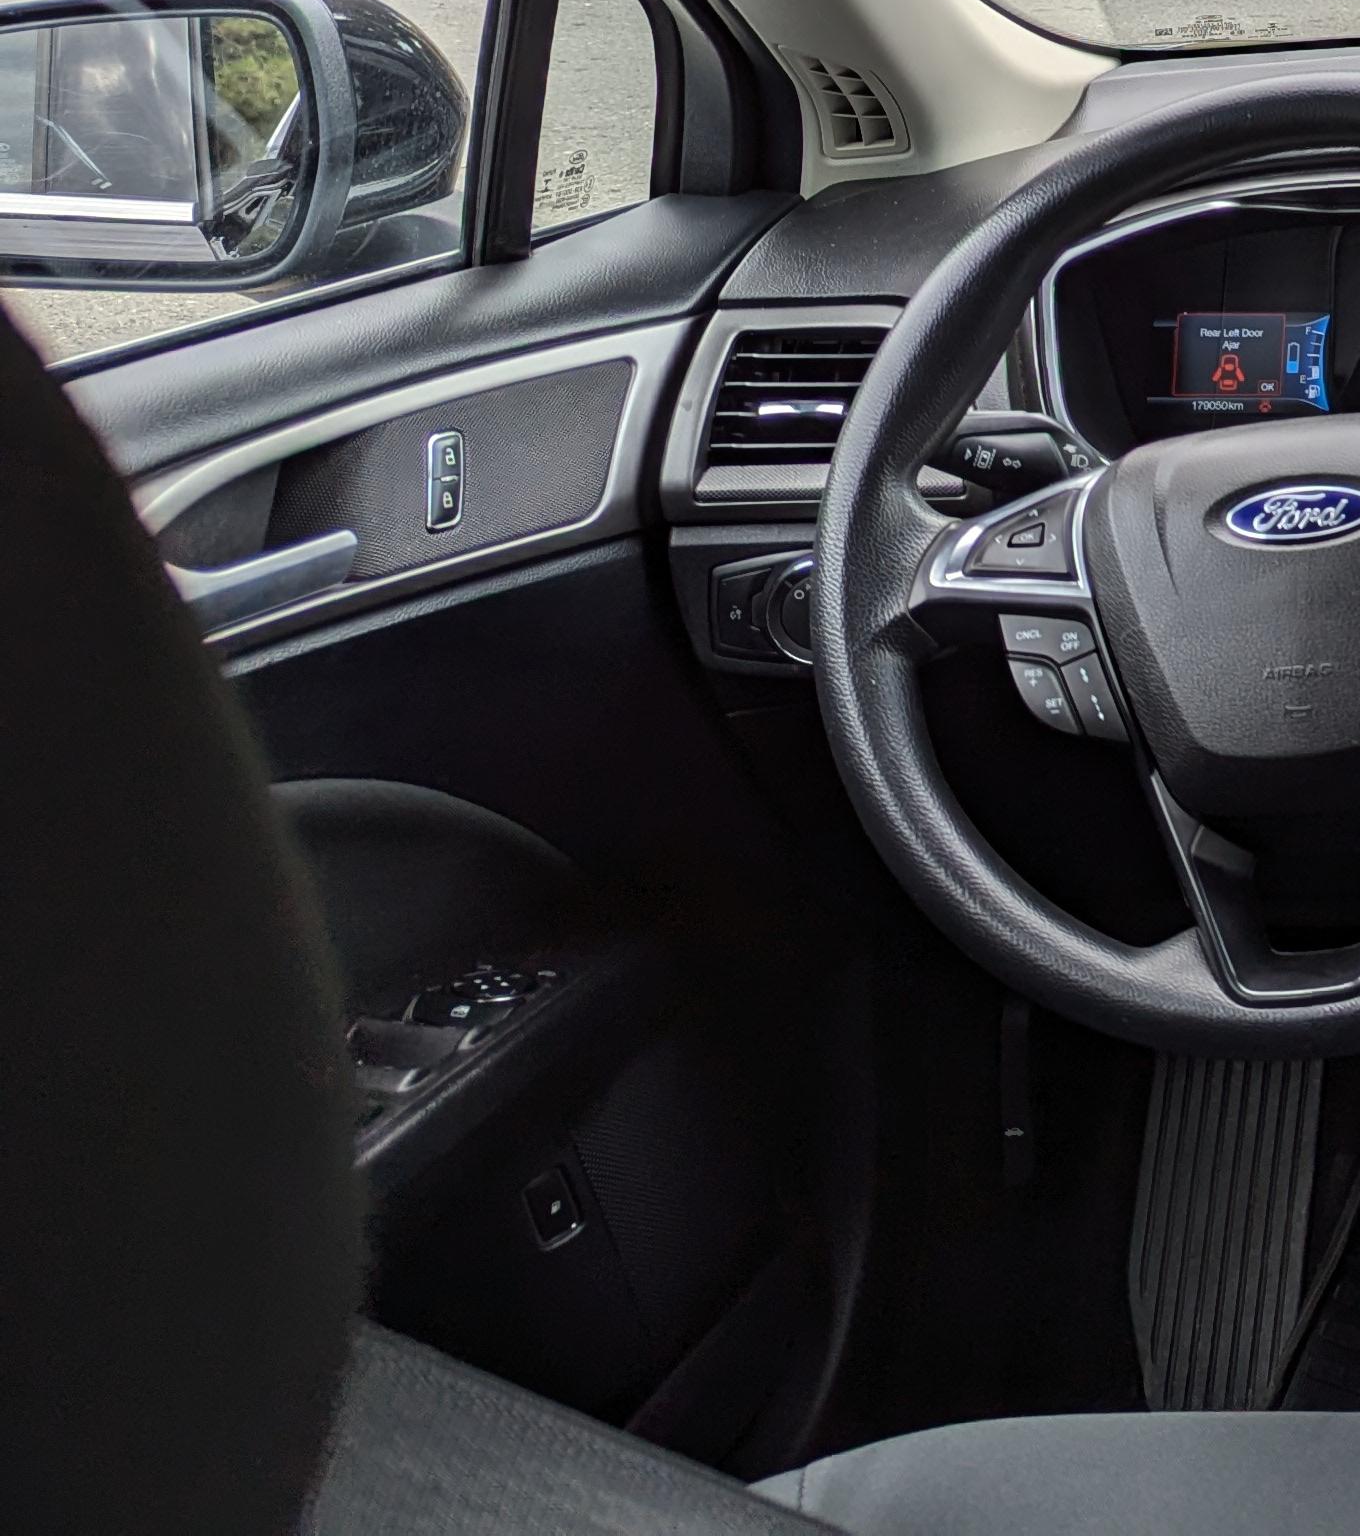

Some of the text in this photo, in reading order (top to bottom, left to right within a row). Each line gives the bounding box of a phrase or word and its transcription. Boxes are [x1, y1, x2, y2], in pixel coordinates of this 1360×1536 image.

[1200, 328, 1264, 337] Rear Left Door
[1222, 340, 1240, 351] Ajar
[1260, 382, 1275, 392] OK
[1252, 492, 1349, 532] Ford
[1015, 629, 1042, 641] CNCL
[1062, 631, 1078, 641] ON
[1061, 641, 1080, 651] OFF
[1024, 668, 1043, 678] RES
[1045, 698, 1063, 709] SET
